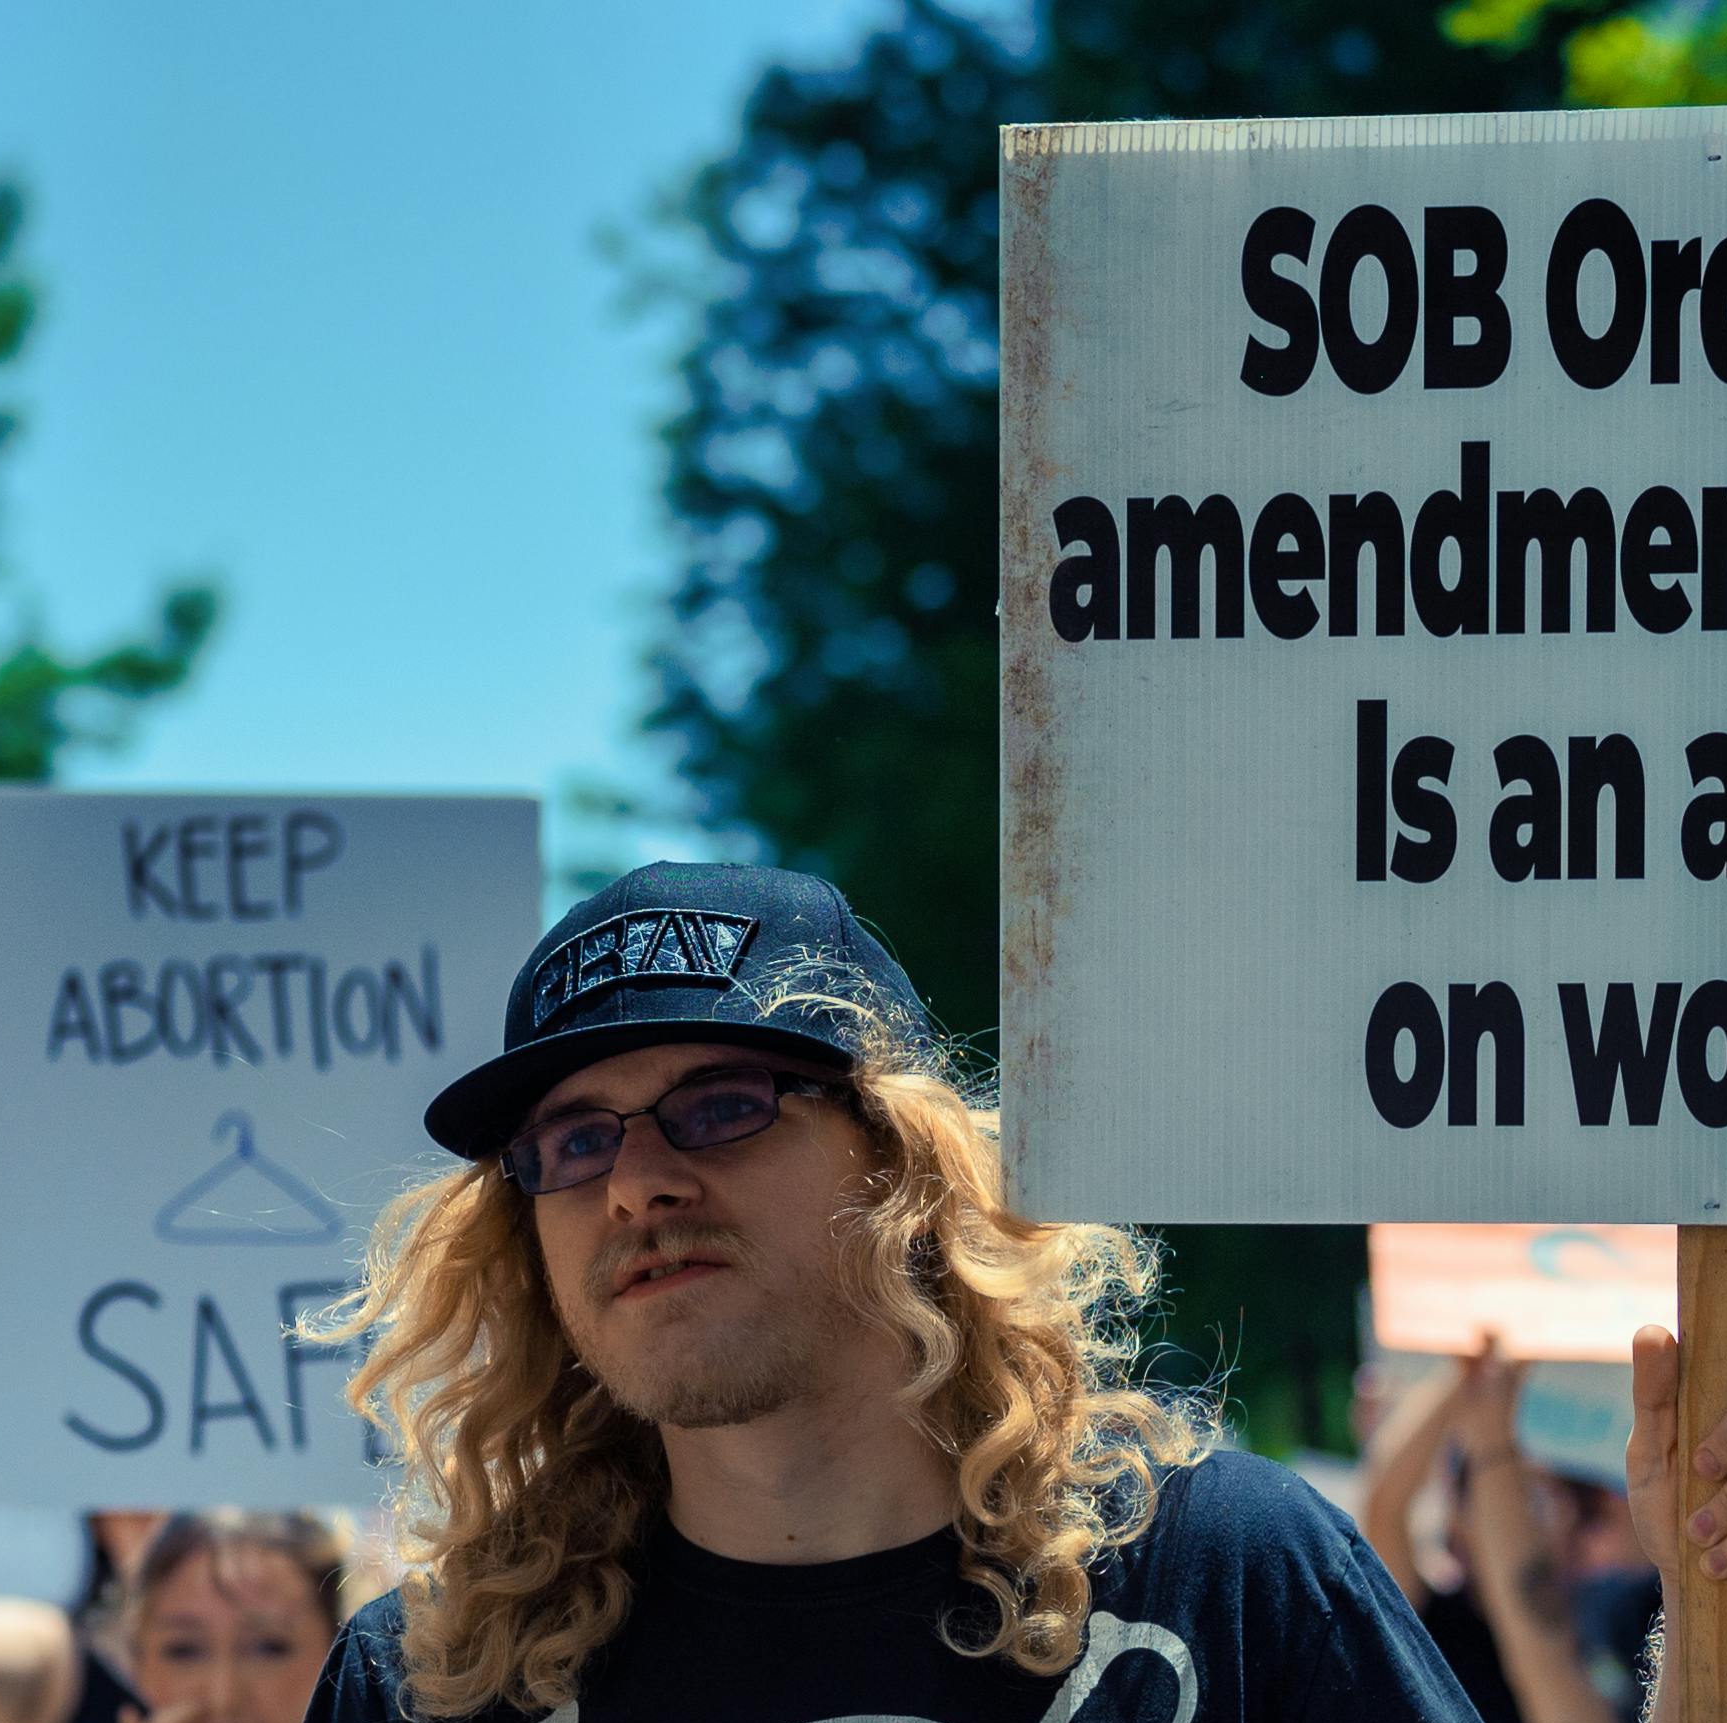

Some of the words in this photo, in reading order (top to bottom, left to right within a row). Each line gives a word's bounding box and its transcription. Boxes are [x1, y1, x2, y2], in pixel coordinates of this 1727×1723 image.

[1240, 204, 1512, 396] SOB
[1357, 699, 1457, 883] Is
[1489, 734, 1645, 882] an
[120, 806, 347, 924] KEEP
[47, 942, 445, 1072] ABORTION
[1365, 981, 1524, 1128] on
